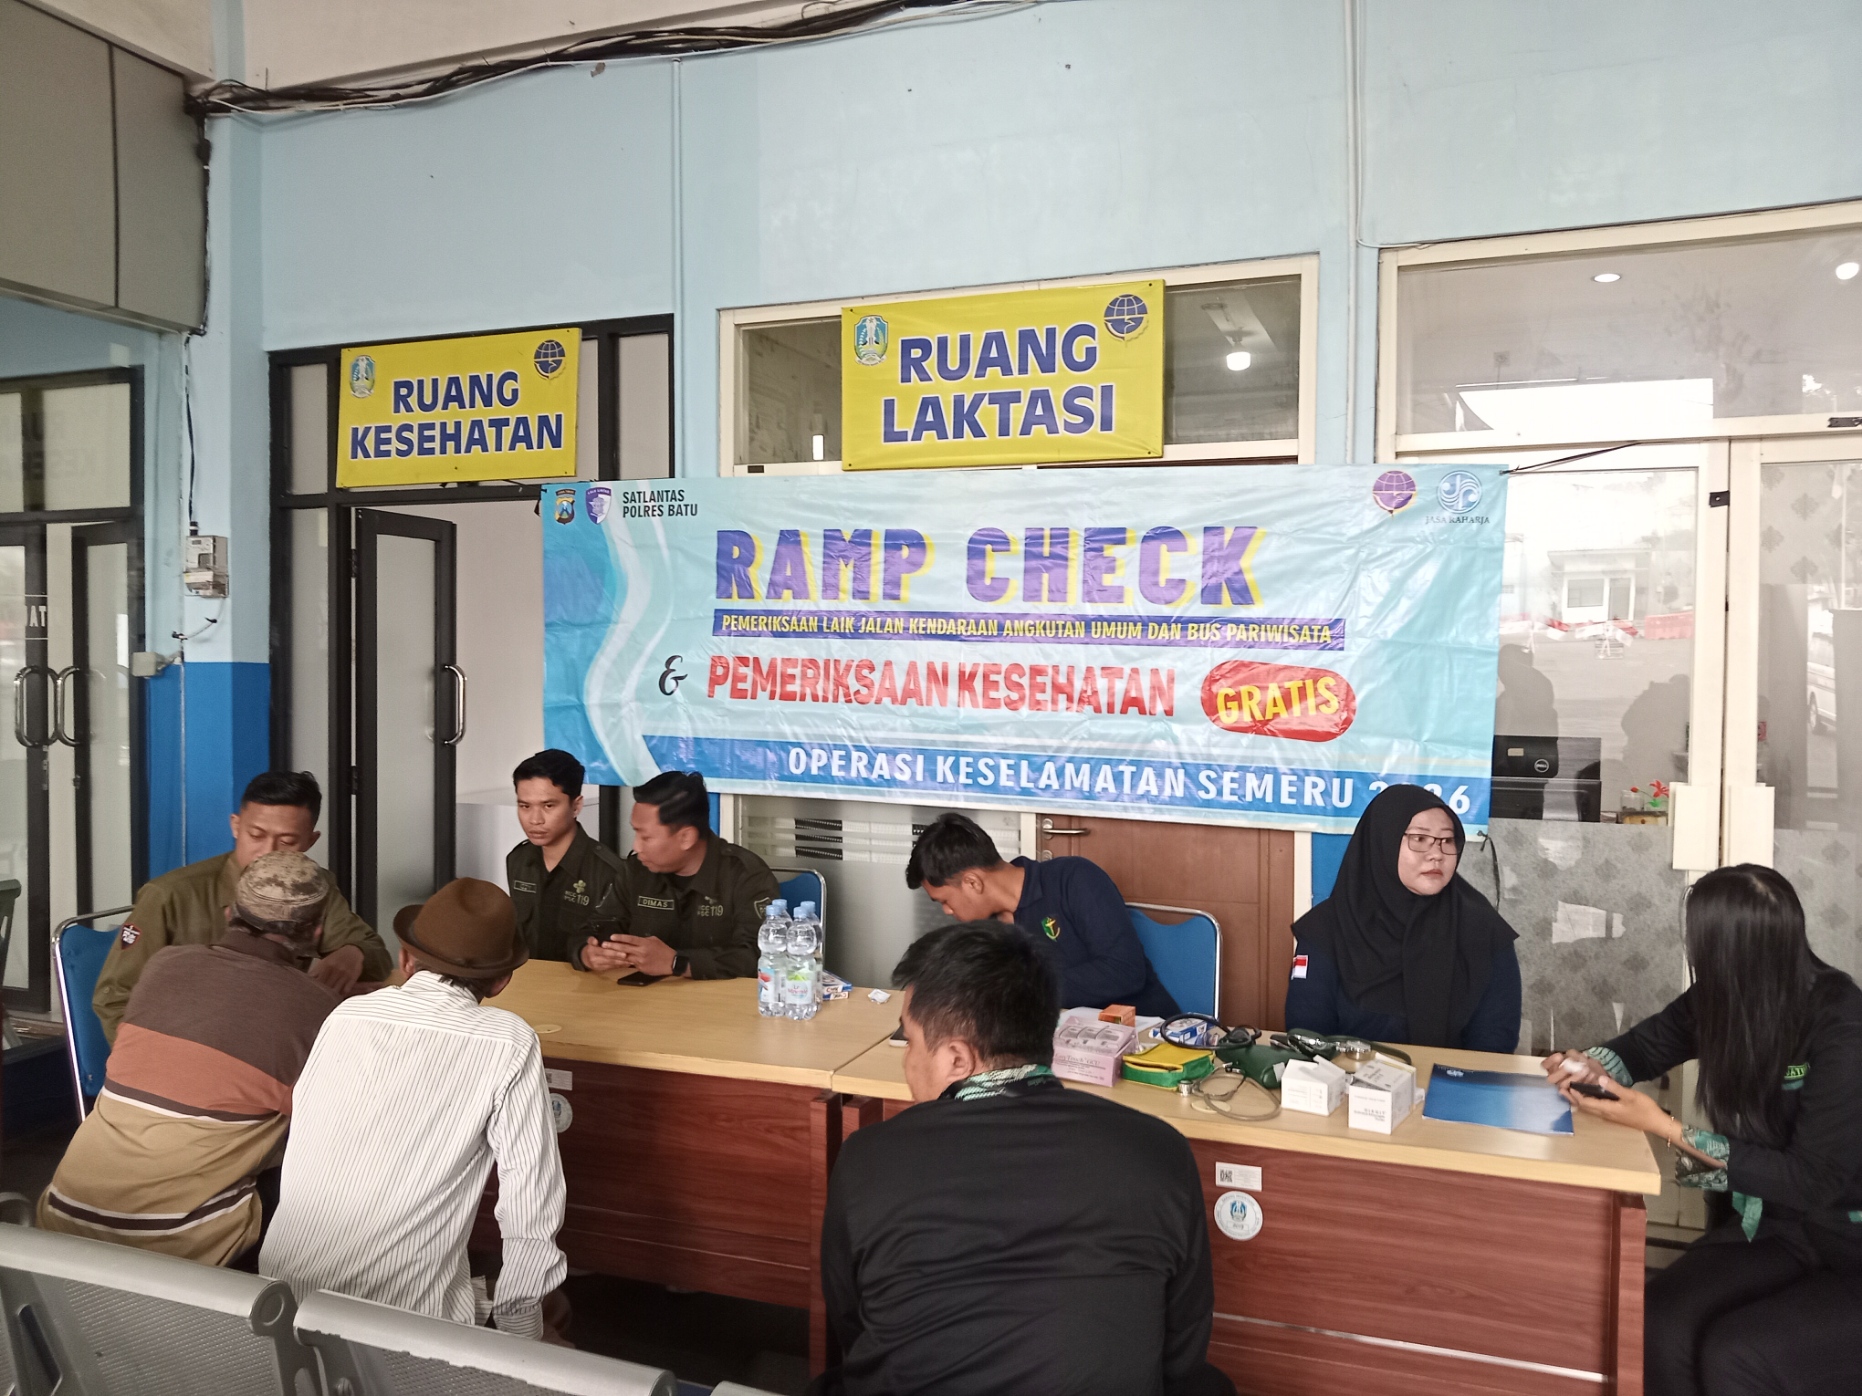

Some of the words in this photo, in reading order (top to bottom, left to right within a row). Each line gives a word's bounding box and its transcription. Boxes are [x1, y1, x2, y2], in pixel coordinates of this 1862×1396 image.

[900, 323, 1098, 384] RUANG
[393, 371, 519, 414] RUANG
[882, 384, 1114, 443] LAKTASI
[350, 414, 563, 460] KESEHATAN
[622, 489, 686, 504] SATLANTAS
[622, 504, 664, 518] POLRES
[667, 503, 698, 517] BATU
[716, 528, 931, 602] RAMP
[966, 526, 1264, 607] CHECK
[722, 614, 818, 633] PEMERIKSAAN
[823, 616, 855, 633] LAIK
[858, 617, 904, 634] JALAN
[909, 618, 998, 636] KENDARAAN
[1002, 619, 1085, 638] ANGKUTAN
[1091, 621, 1142, 639] UMUM
[1147, 622, 1181, 640] DAN
[1187, 623, 1221, 641] BUS
[1225, 623, 1332, 643] PARIWISATA
[658, 654, 688, 696] &
[707, 655, 949, 707] PEMERIKSAAN
[957, 661, 1175, 717] KESEHATAN
[1216, 676, 1340, 724] GRATIS
[788, 747, 925, 782] OPERASI
[936, 755, 1186, 798] KESELAMATAN
[1198, 769, 1354, 808] SEMERU
[643, 898, 669, 909] DIMAS
